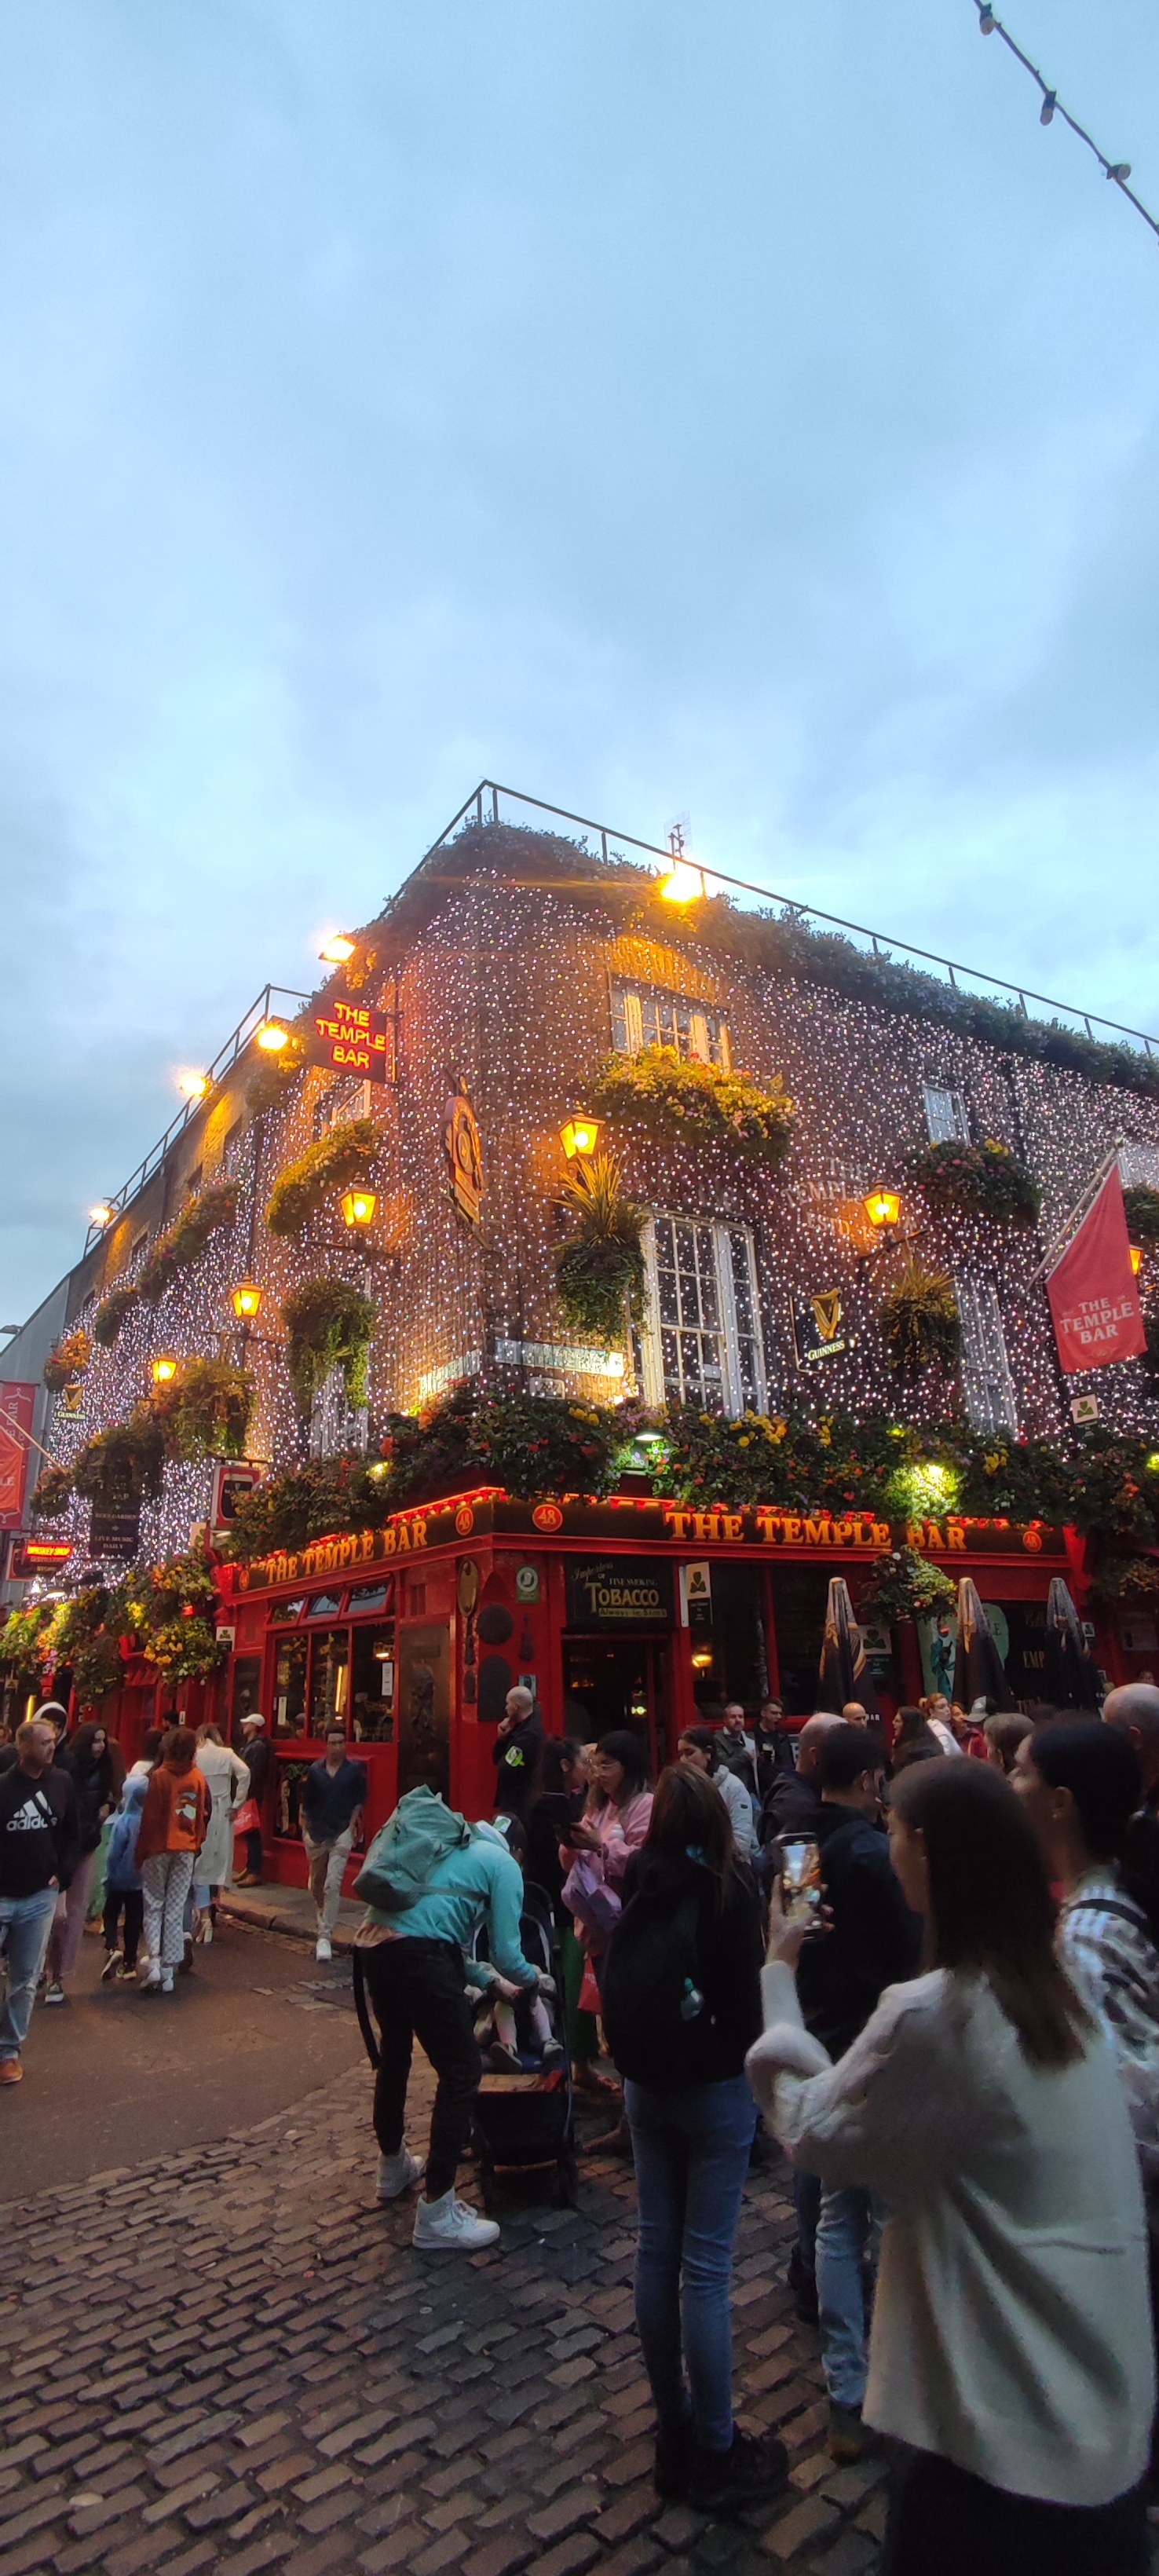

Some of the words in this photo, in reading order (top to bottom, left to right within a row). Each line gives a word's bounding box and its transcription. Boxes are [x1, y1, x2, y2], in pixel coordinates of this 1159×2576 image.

[334, 1002, 371, 1027] THE
[316, 1018, 386, 1052] TEMPLE
[333, 1045, 371, 1070] BAR
[1078, 1297, 1111, 1314] THE
[1060, 1301, 1135, 1334] TEMPLE
[1080, 1323, 1119, 1345] BAR
[807, 1339, 846, 1361] GUINNESS
[459, 1513, 470, 1530] 48
[538, 1508, 556, 1524] 48
[665, 1512, 745, 1541] THE
[756, 1516, 892, 1547] TEMPLE
[908, 1523, 967, 1550] BAR
[266, 1557, 298, 1584] THE
[302, 1535, 375, 1575] TEMPLE
[383, 1520, 428, 1555] BAR
[609, 1577, 625, 1586] FINE
[627, 1578, 658, 1586] SMOKING
